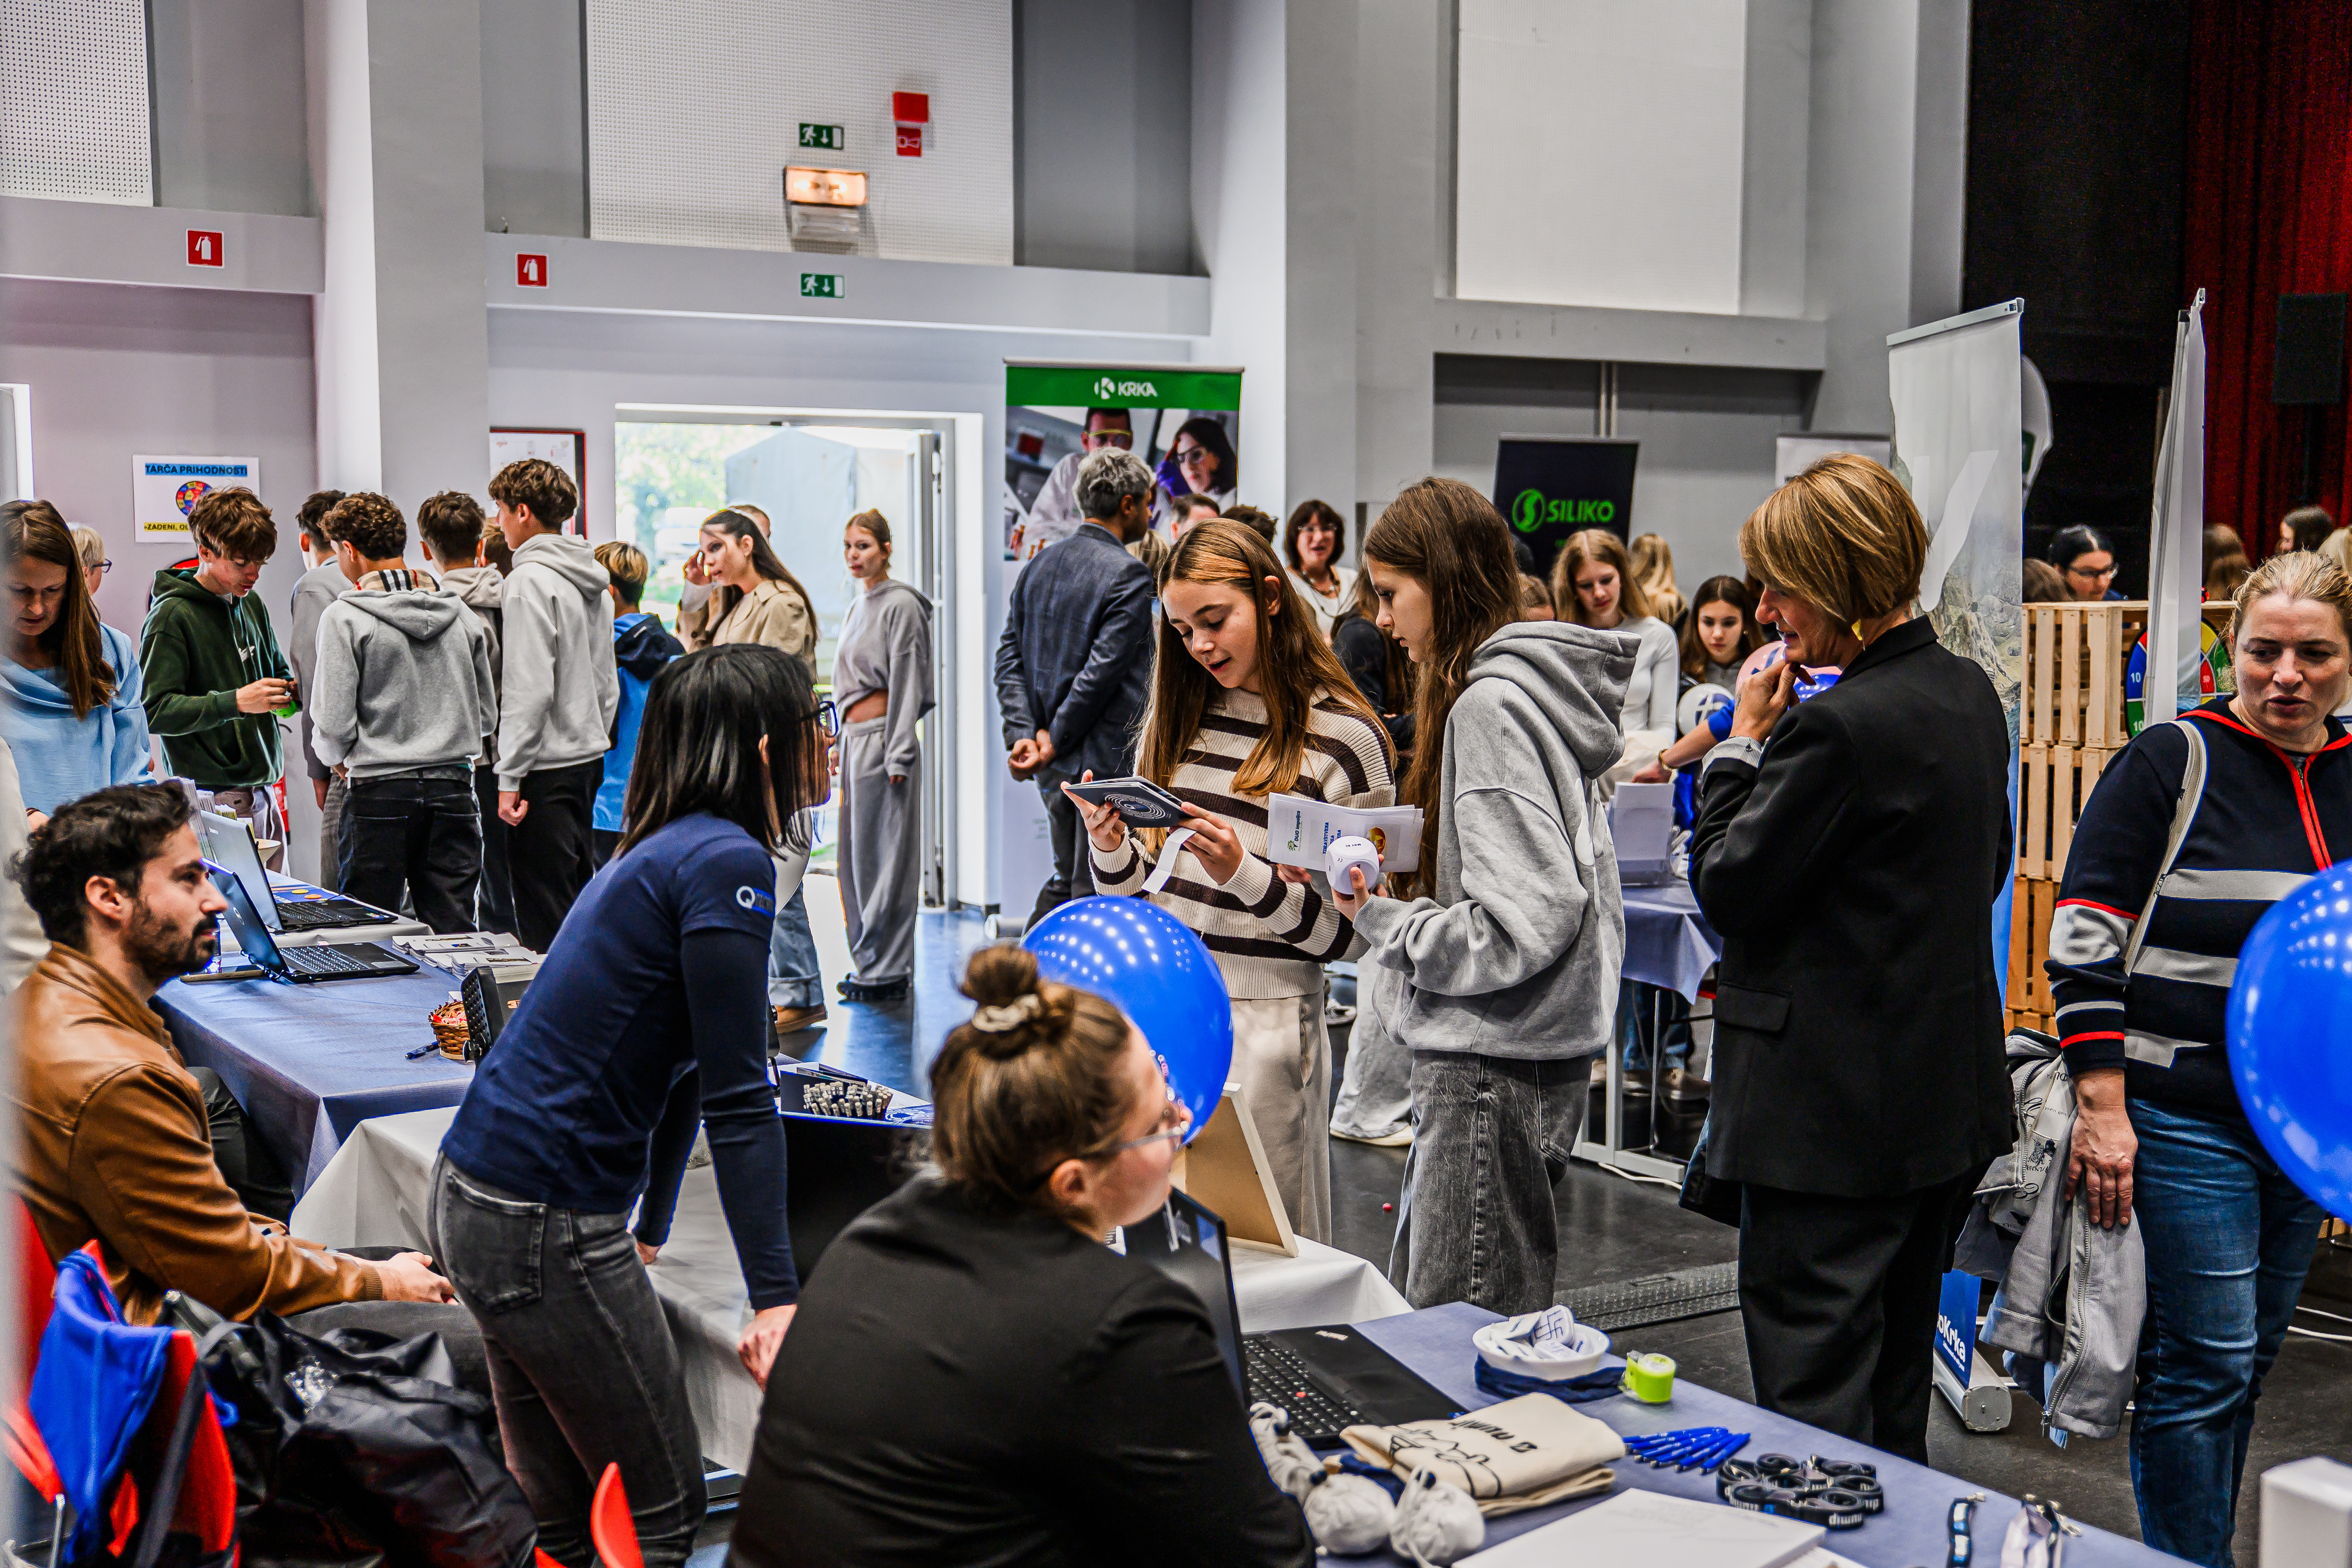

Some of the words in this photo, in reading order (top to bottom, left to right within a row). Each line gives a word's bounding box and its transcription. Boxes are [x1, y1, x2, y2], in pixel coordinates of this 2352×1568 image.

[1118, 382, 1158, 396] KRKA
[145, 463, 179, 473] TARČA
[180, 465, 247, 475] PRIHODNOSTI
[1547, 500, 1613, 522] SILIKO
[2130, 672, 2141, 683] 10
[2133, 721, 2144, 731] 10
[1937, 1314, 1966, 1363] oKrka
